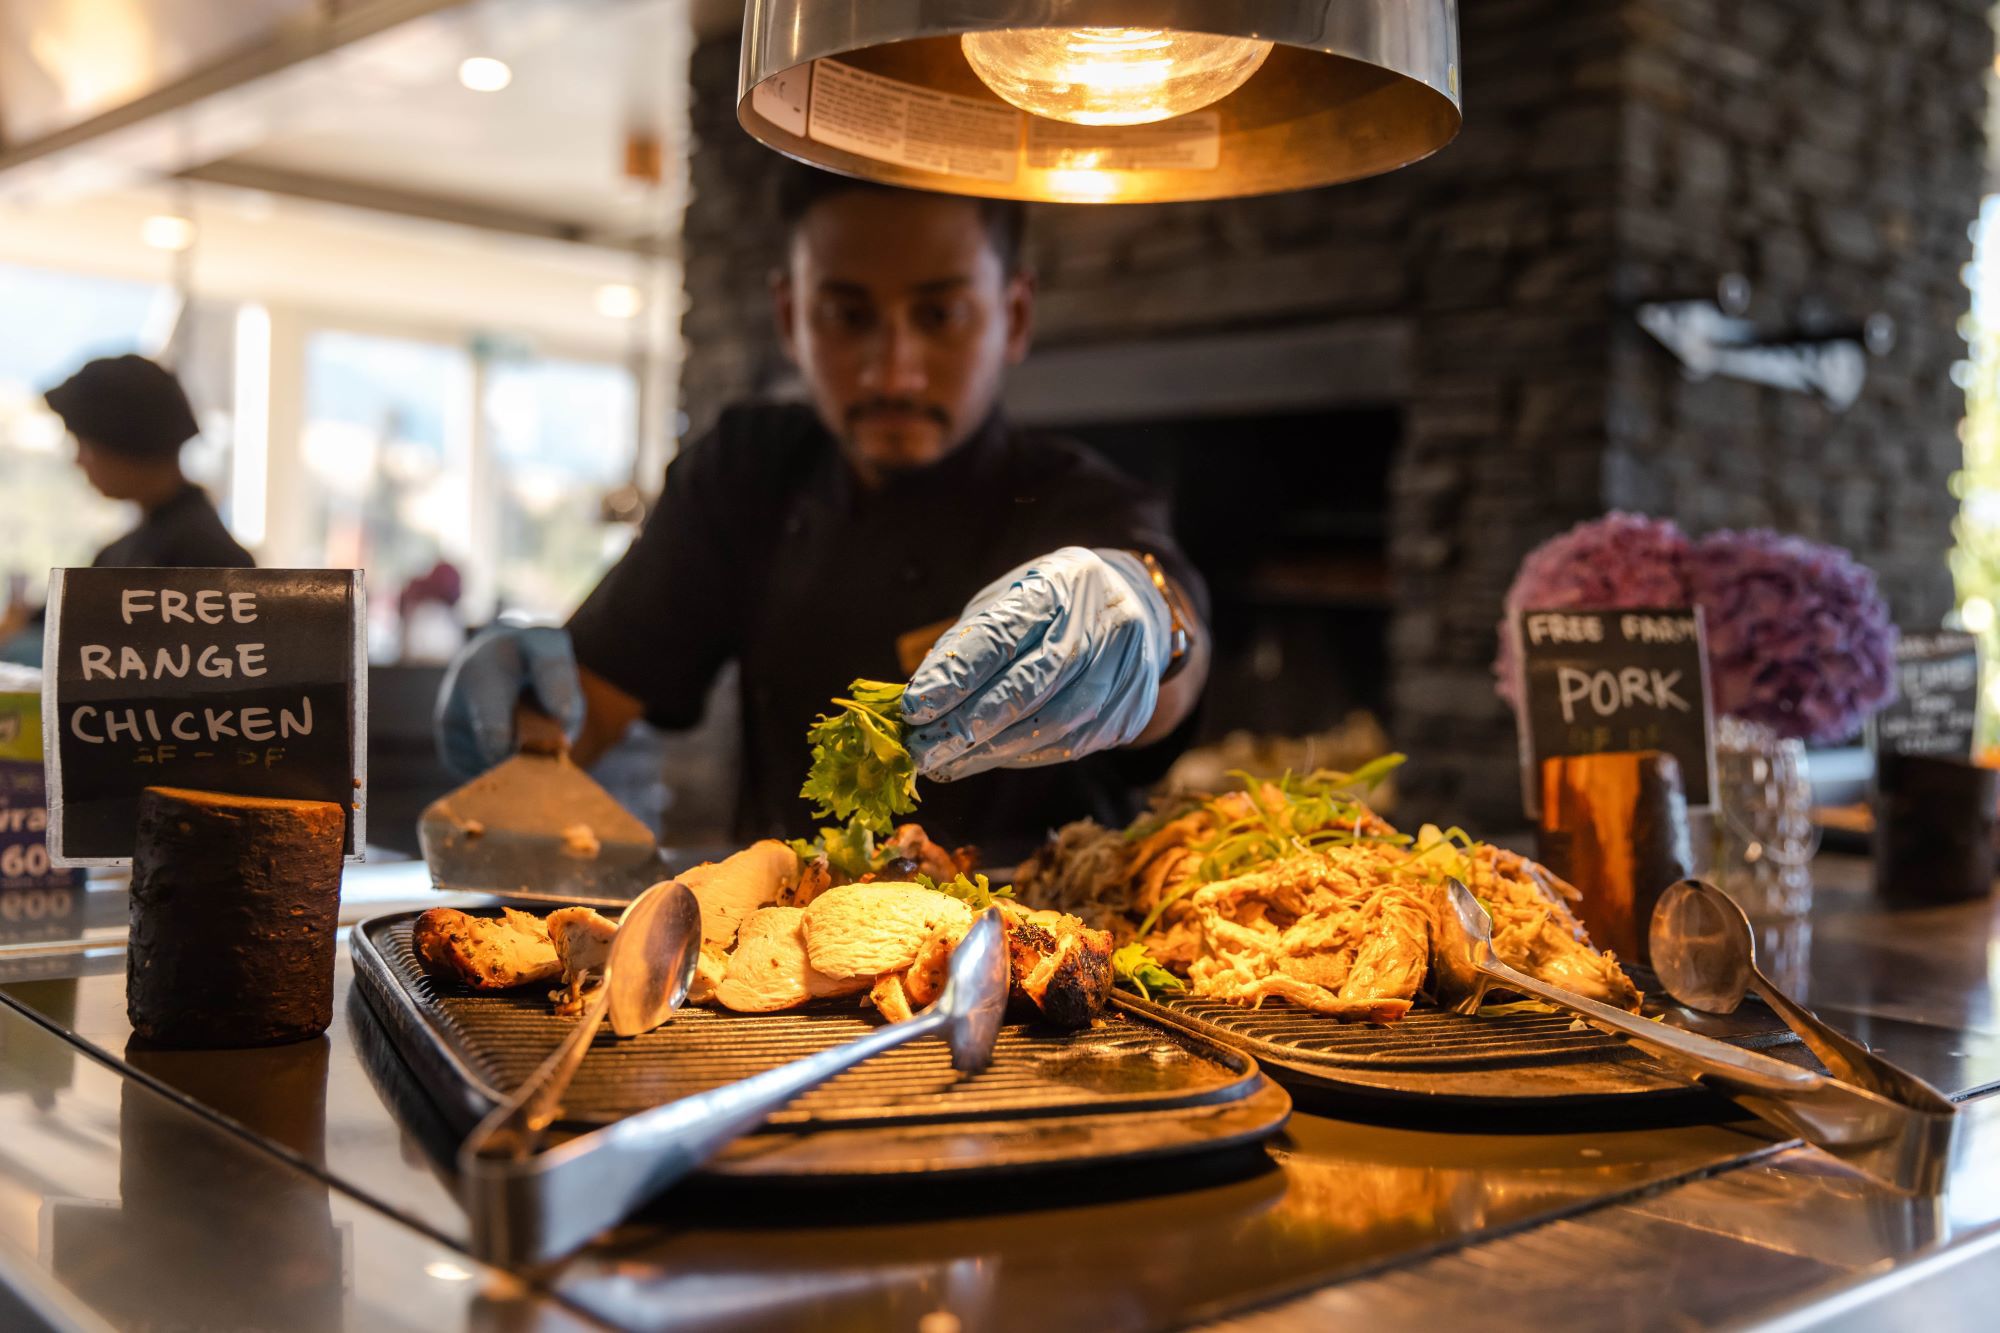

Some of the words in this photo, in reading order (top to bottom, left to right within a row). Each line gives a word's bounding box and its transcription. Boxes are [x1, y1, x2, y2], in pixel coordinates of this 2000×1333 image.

[122, 589, 258, 624] FREE
[1527, 614, 1603, 645] FREE
[80, 643, 268, 680] RANGE
[1557, 666, 1691, 723] PORK
[71, 696, 313, 743] CHICKEN
[2, 844, 71, 877] 60
